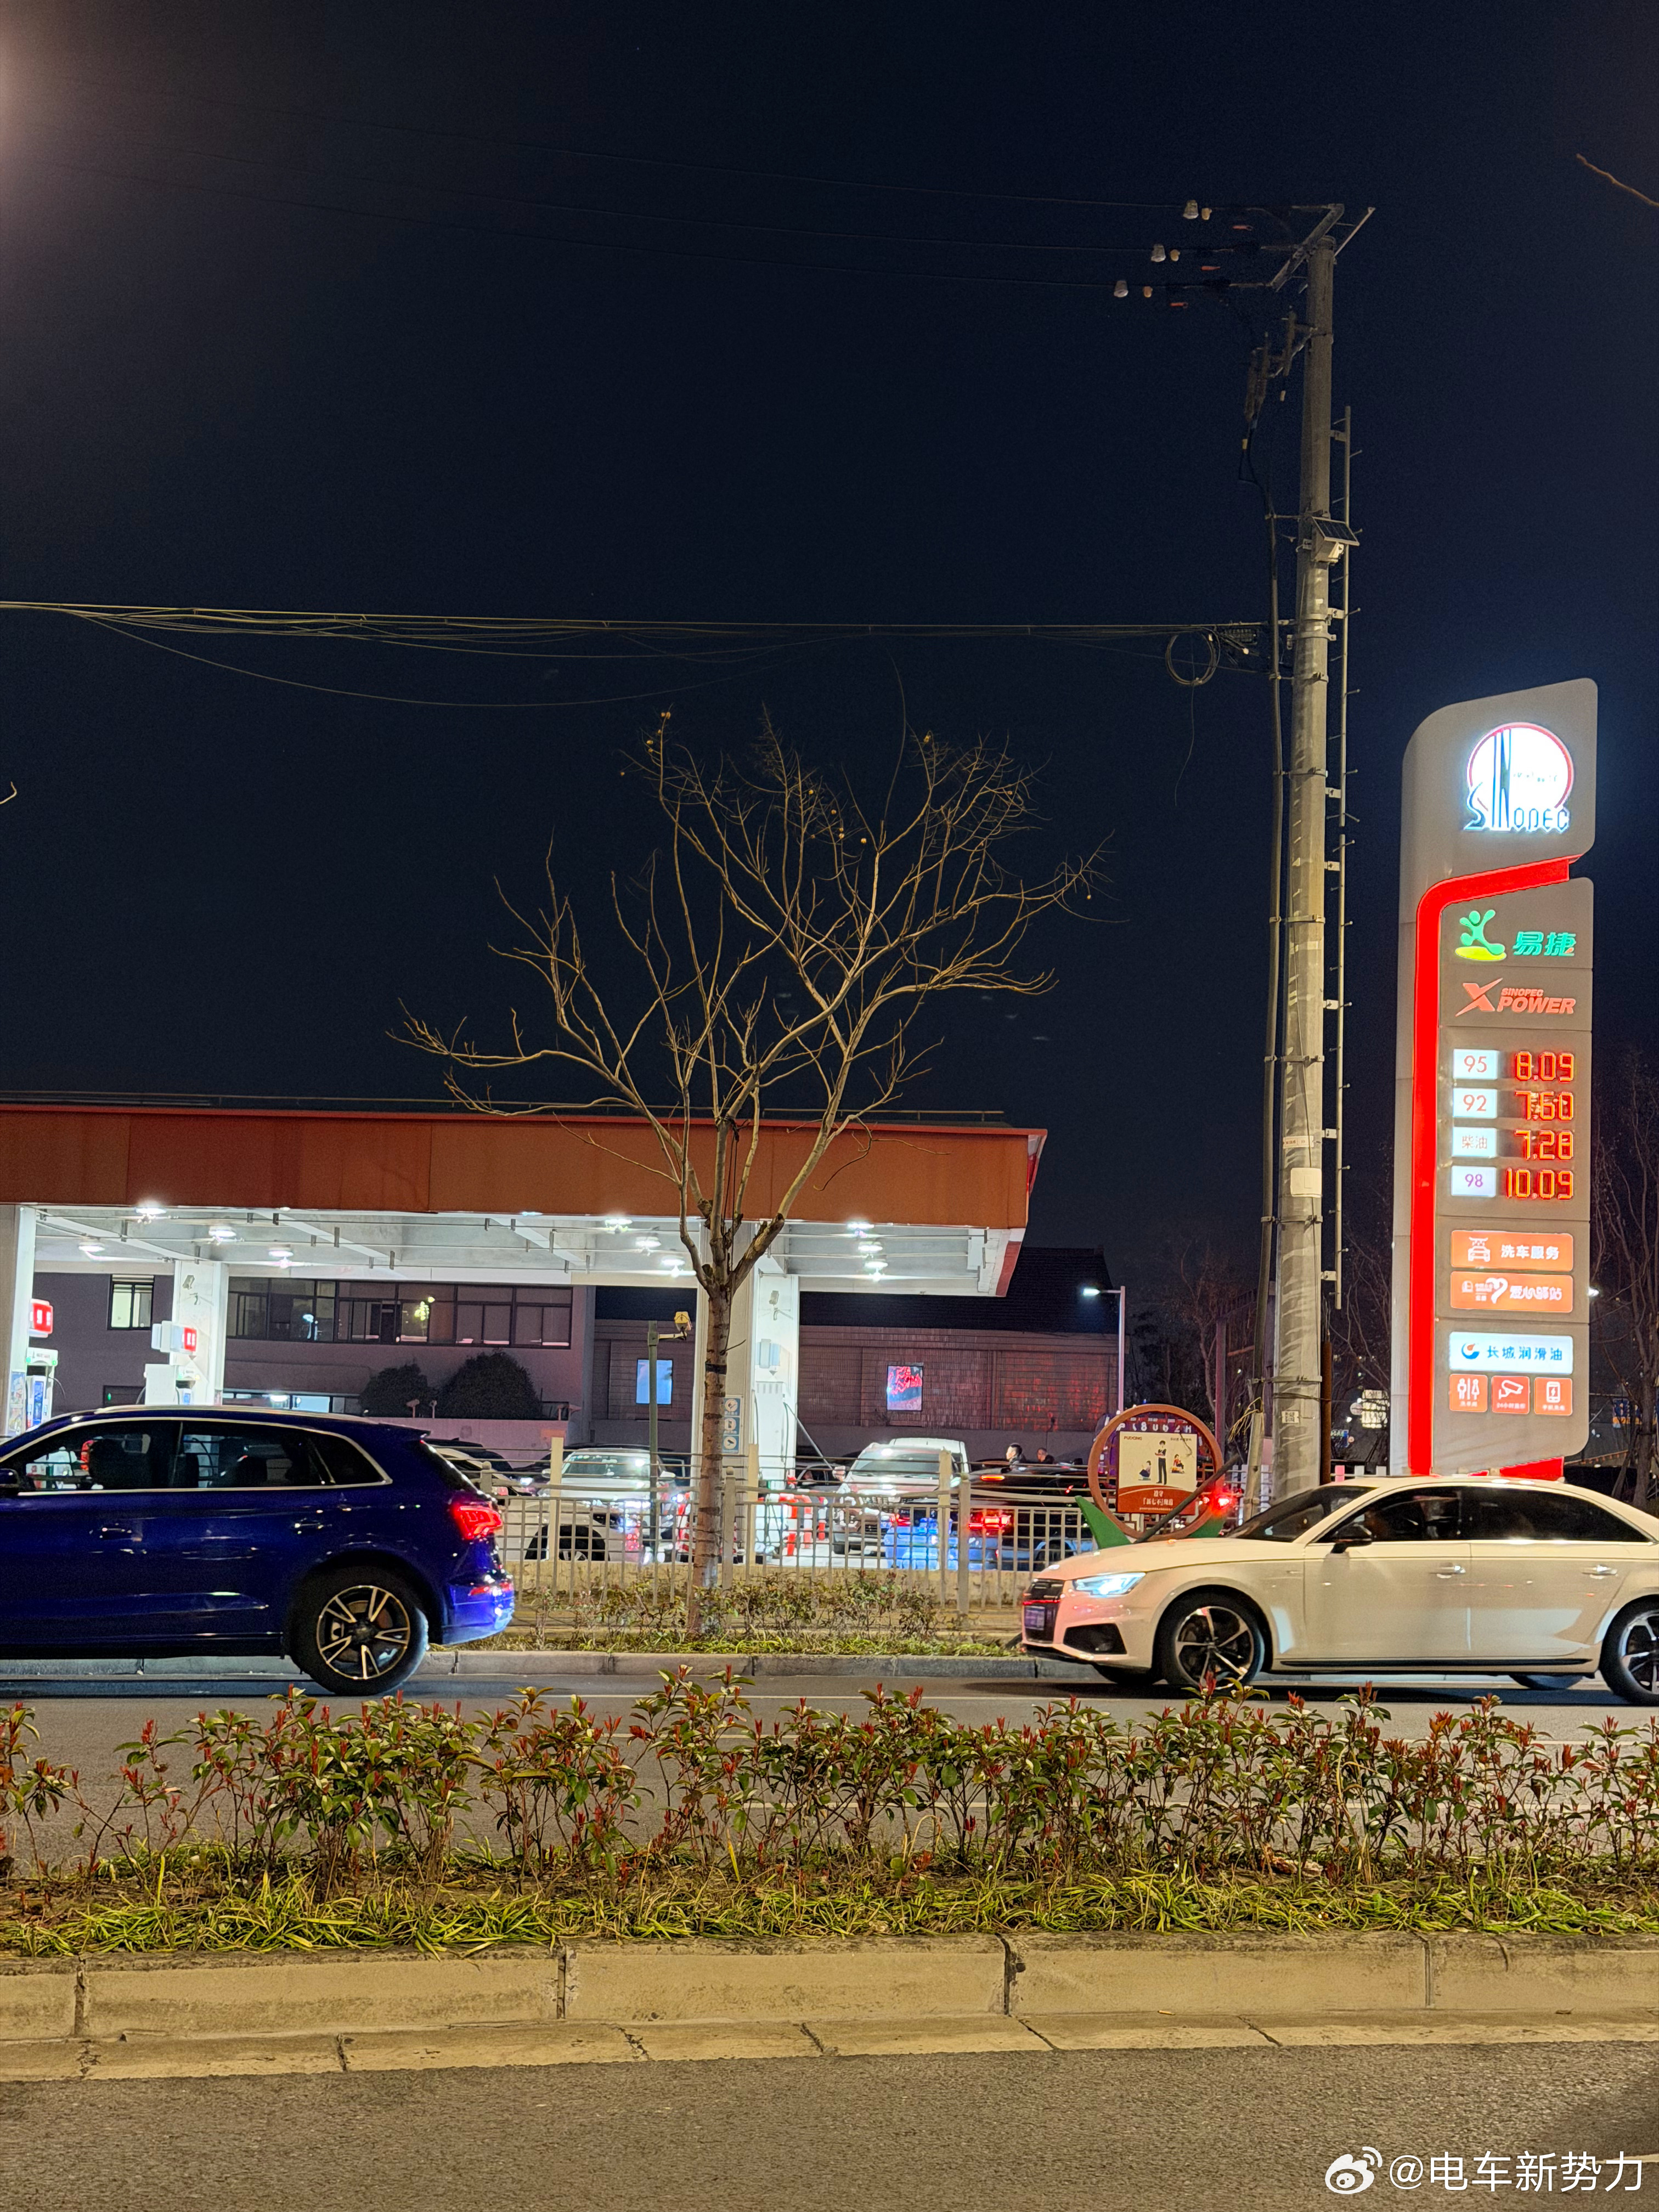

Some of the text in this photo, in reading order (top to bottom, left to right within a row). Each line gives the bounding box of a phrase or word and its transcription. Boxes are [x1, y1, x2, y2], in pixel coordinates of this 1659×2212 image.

[1513, 931, 1576, 956] 易捷
[1501, 988, 1544, 997] SINOPEC
[1464, 1050, 1575, 1083] 95 8.09
[1463, 1090, 1574, 1121] 92 7.60
[1462, 1129, 1574, 1161] 柴油 7.28
[1464, 1167, 1574, 1200] 98 10.09
[1501, 1244, 1560, 1260] 洗车服务
[1487, 1345, 1562, 1361] 长城润滑油
